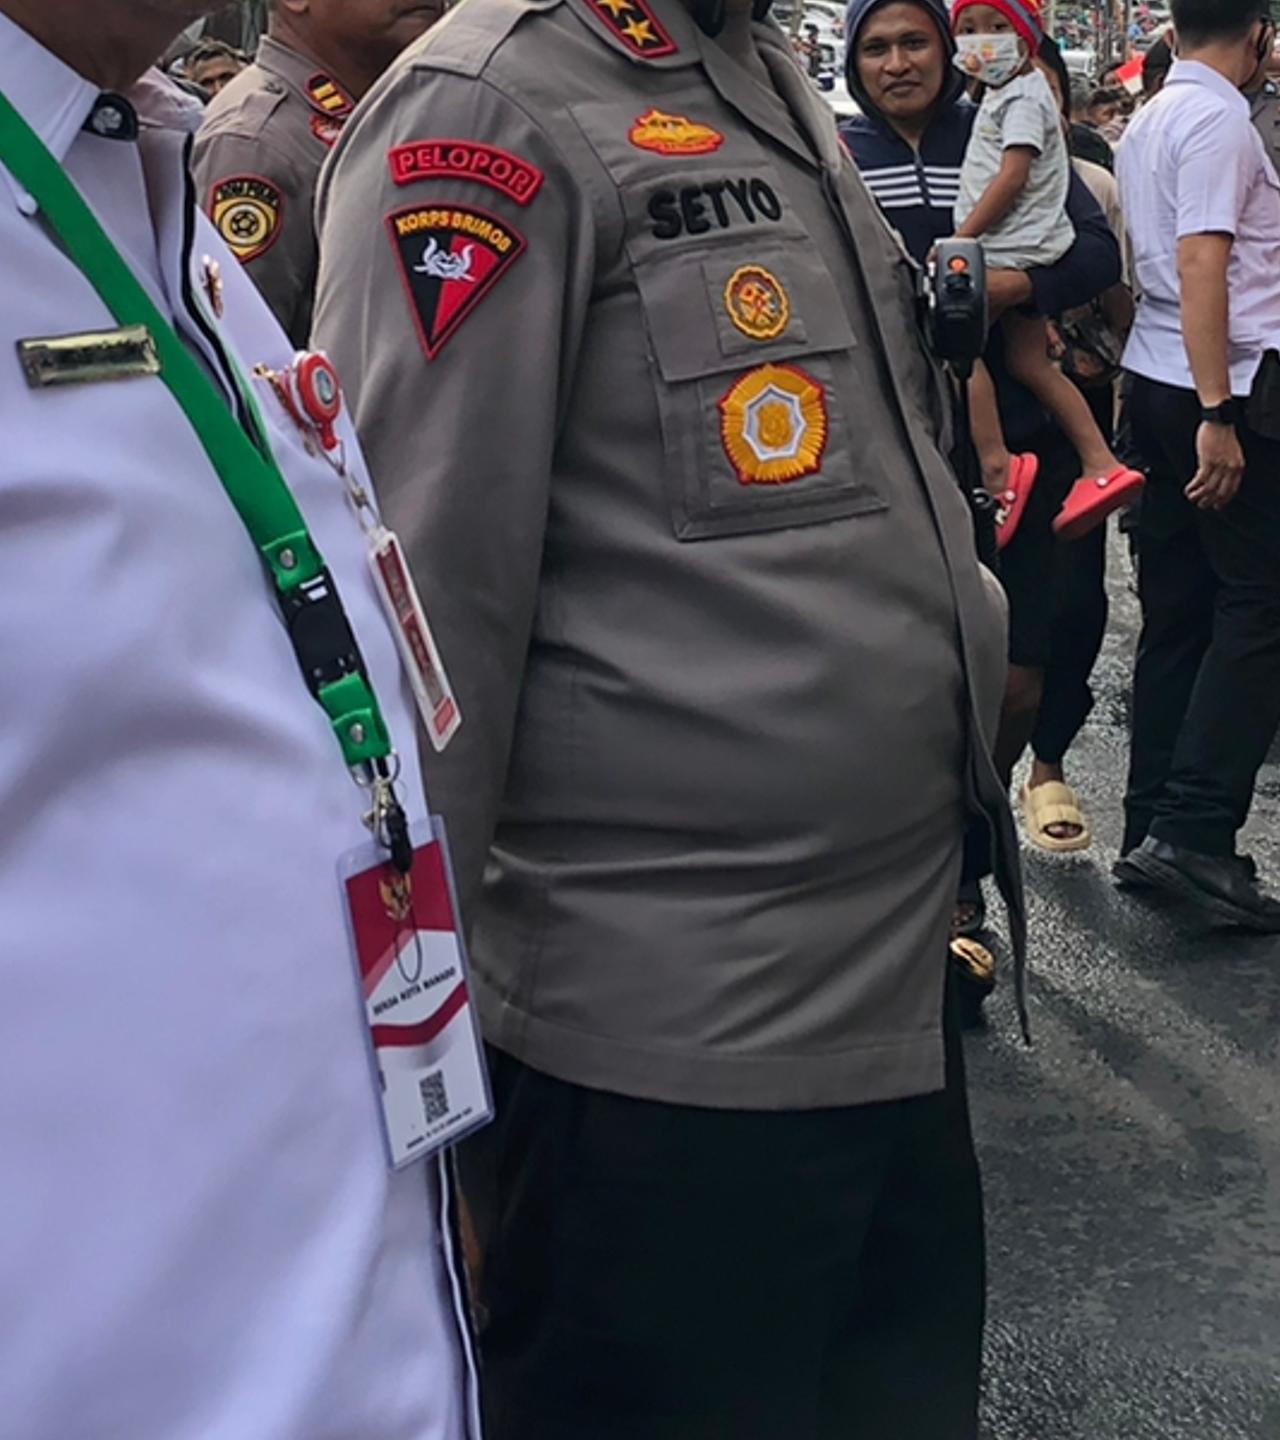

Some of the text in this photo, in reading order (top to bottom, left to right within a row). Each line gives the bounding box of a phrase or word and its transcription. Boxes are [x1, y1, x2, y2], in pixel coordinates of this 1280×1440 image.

[398, 146, 531, 192] PELOPOR
[395, 210, 512, 252] KORPS BRIMOB
[647, 177, 783, 240] SETYO
